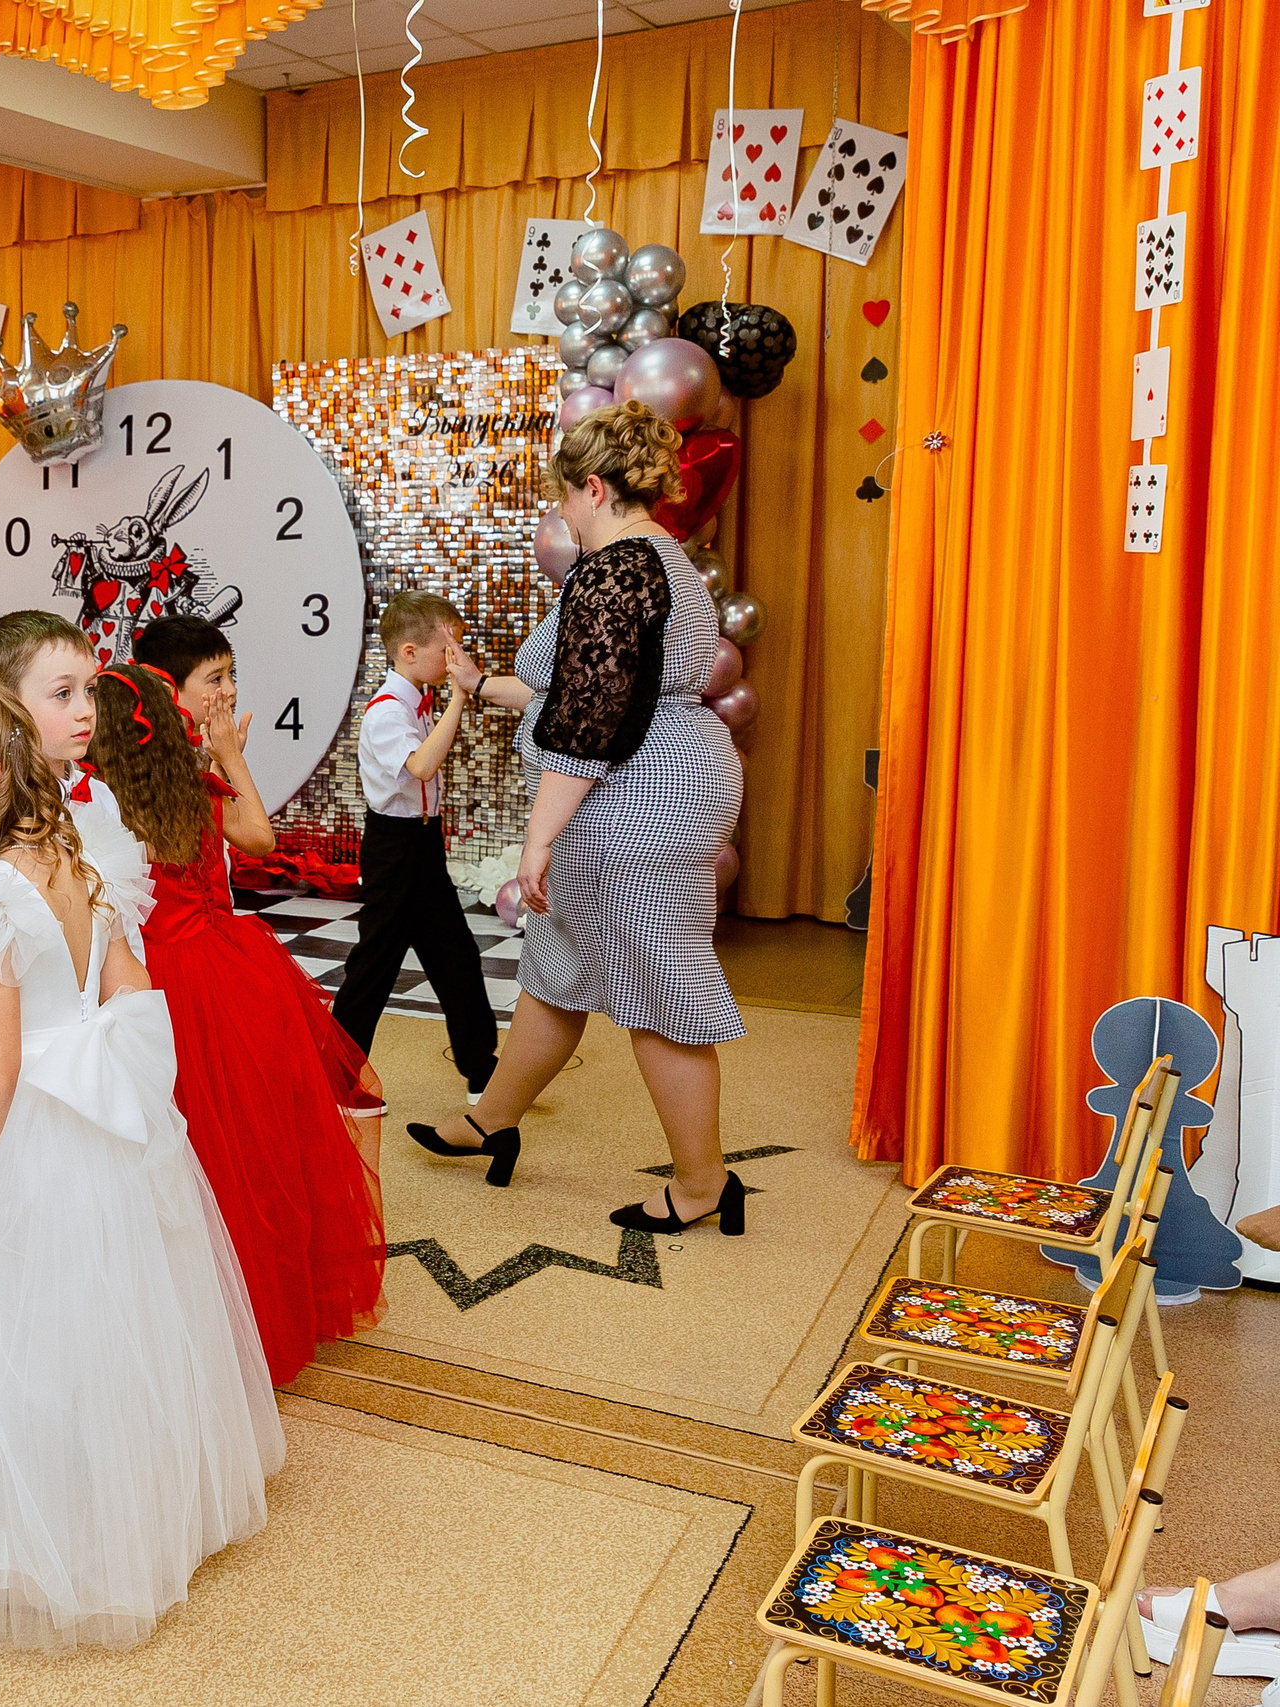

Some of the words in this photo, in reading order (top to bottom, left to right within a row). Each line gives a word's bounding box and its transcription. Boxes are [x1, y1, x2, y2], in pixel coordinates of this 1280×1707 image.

[1146, 82, 1153, 93] 7
[717, 118, 725, 130] 8
[778, 213, 787, 226] 8
[528, 226, 536, 238] 9
[1138, 225, 1145, 236] 10
[364, 243, 371, 254] 8
[859, 242, 871, 256] 10
[438, 295, 445, 306] 8
[119, 412, 171, 456] 12
[217, 438, 232, 480] 1
[441, 459, 518, 489] 2026
[276, 497, 303, 541] 2
[302, 594, 329, 637] 3
[275, 698, 304, 741] 4
